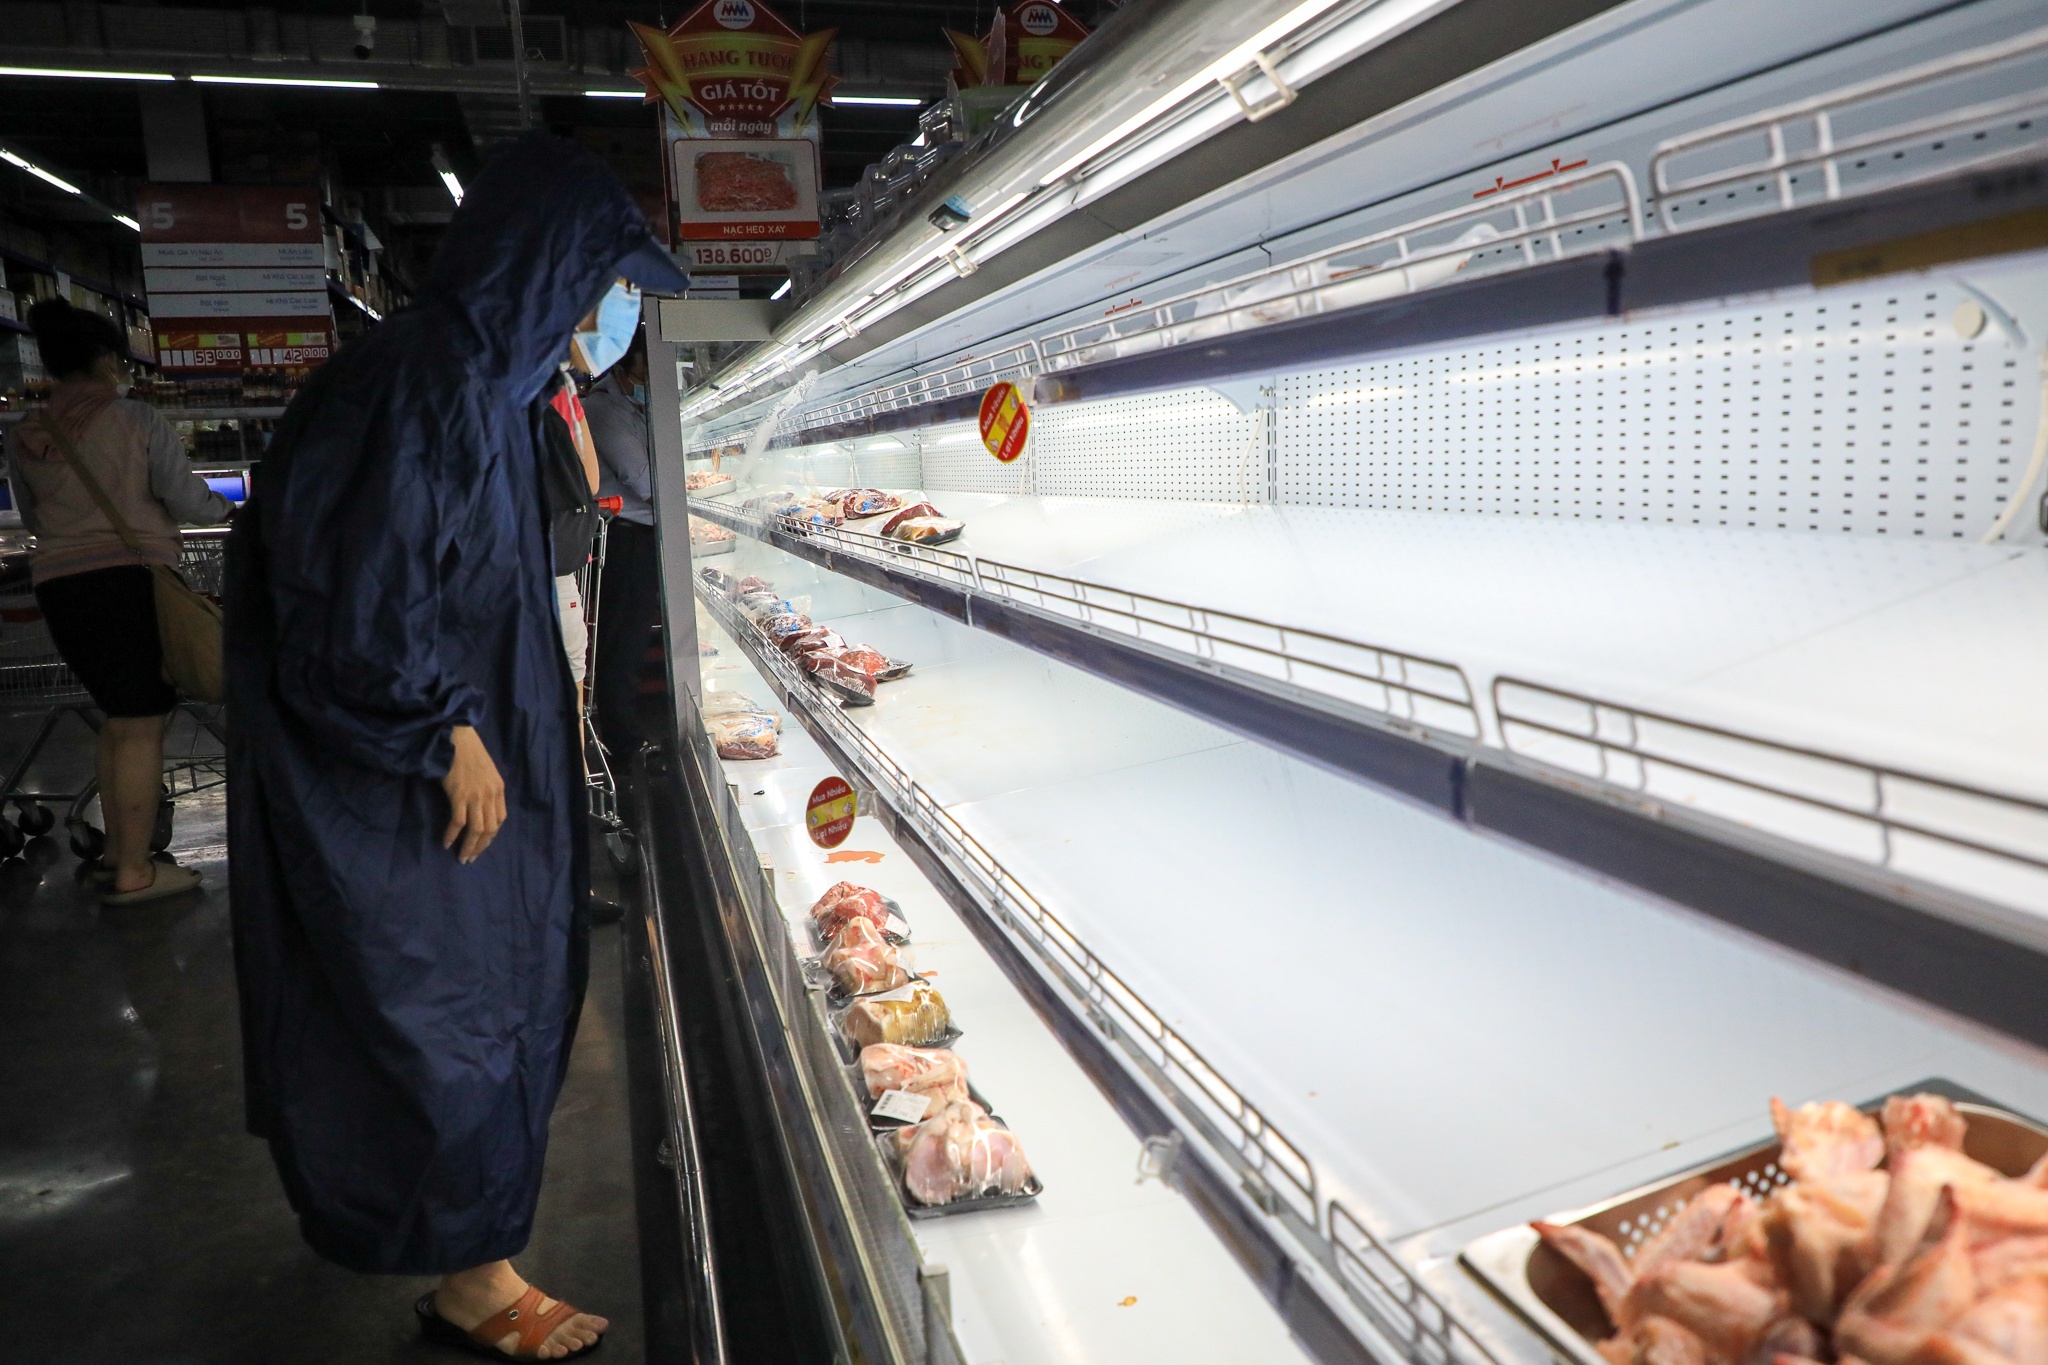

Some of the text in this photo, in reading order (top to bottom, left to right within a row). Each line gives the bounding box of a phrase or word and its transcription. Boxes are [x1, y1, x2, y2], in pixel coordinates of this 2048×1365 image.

[701, 78, 780, 102] GIÁ TỐT
[710, 117, 772, 134] mỗi ngày
[152, 203, 175, 230] 5
[286, 203, 308, 230] 5
[723, 226, 743, 236] NẠC
[768, 225, 785, 233] XAY
[982, 413, 994, 432] Mua
[812, 793, 826, 805] Mua
